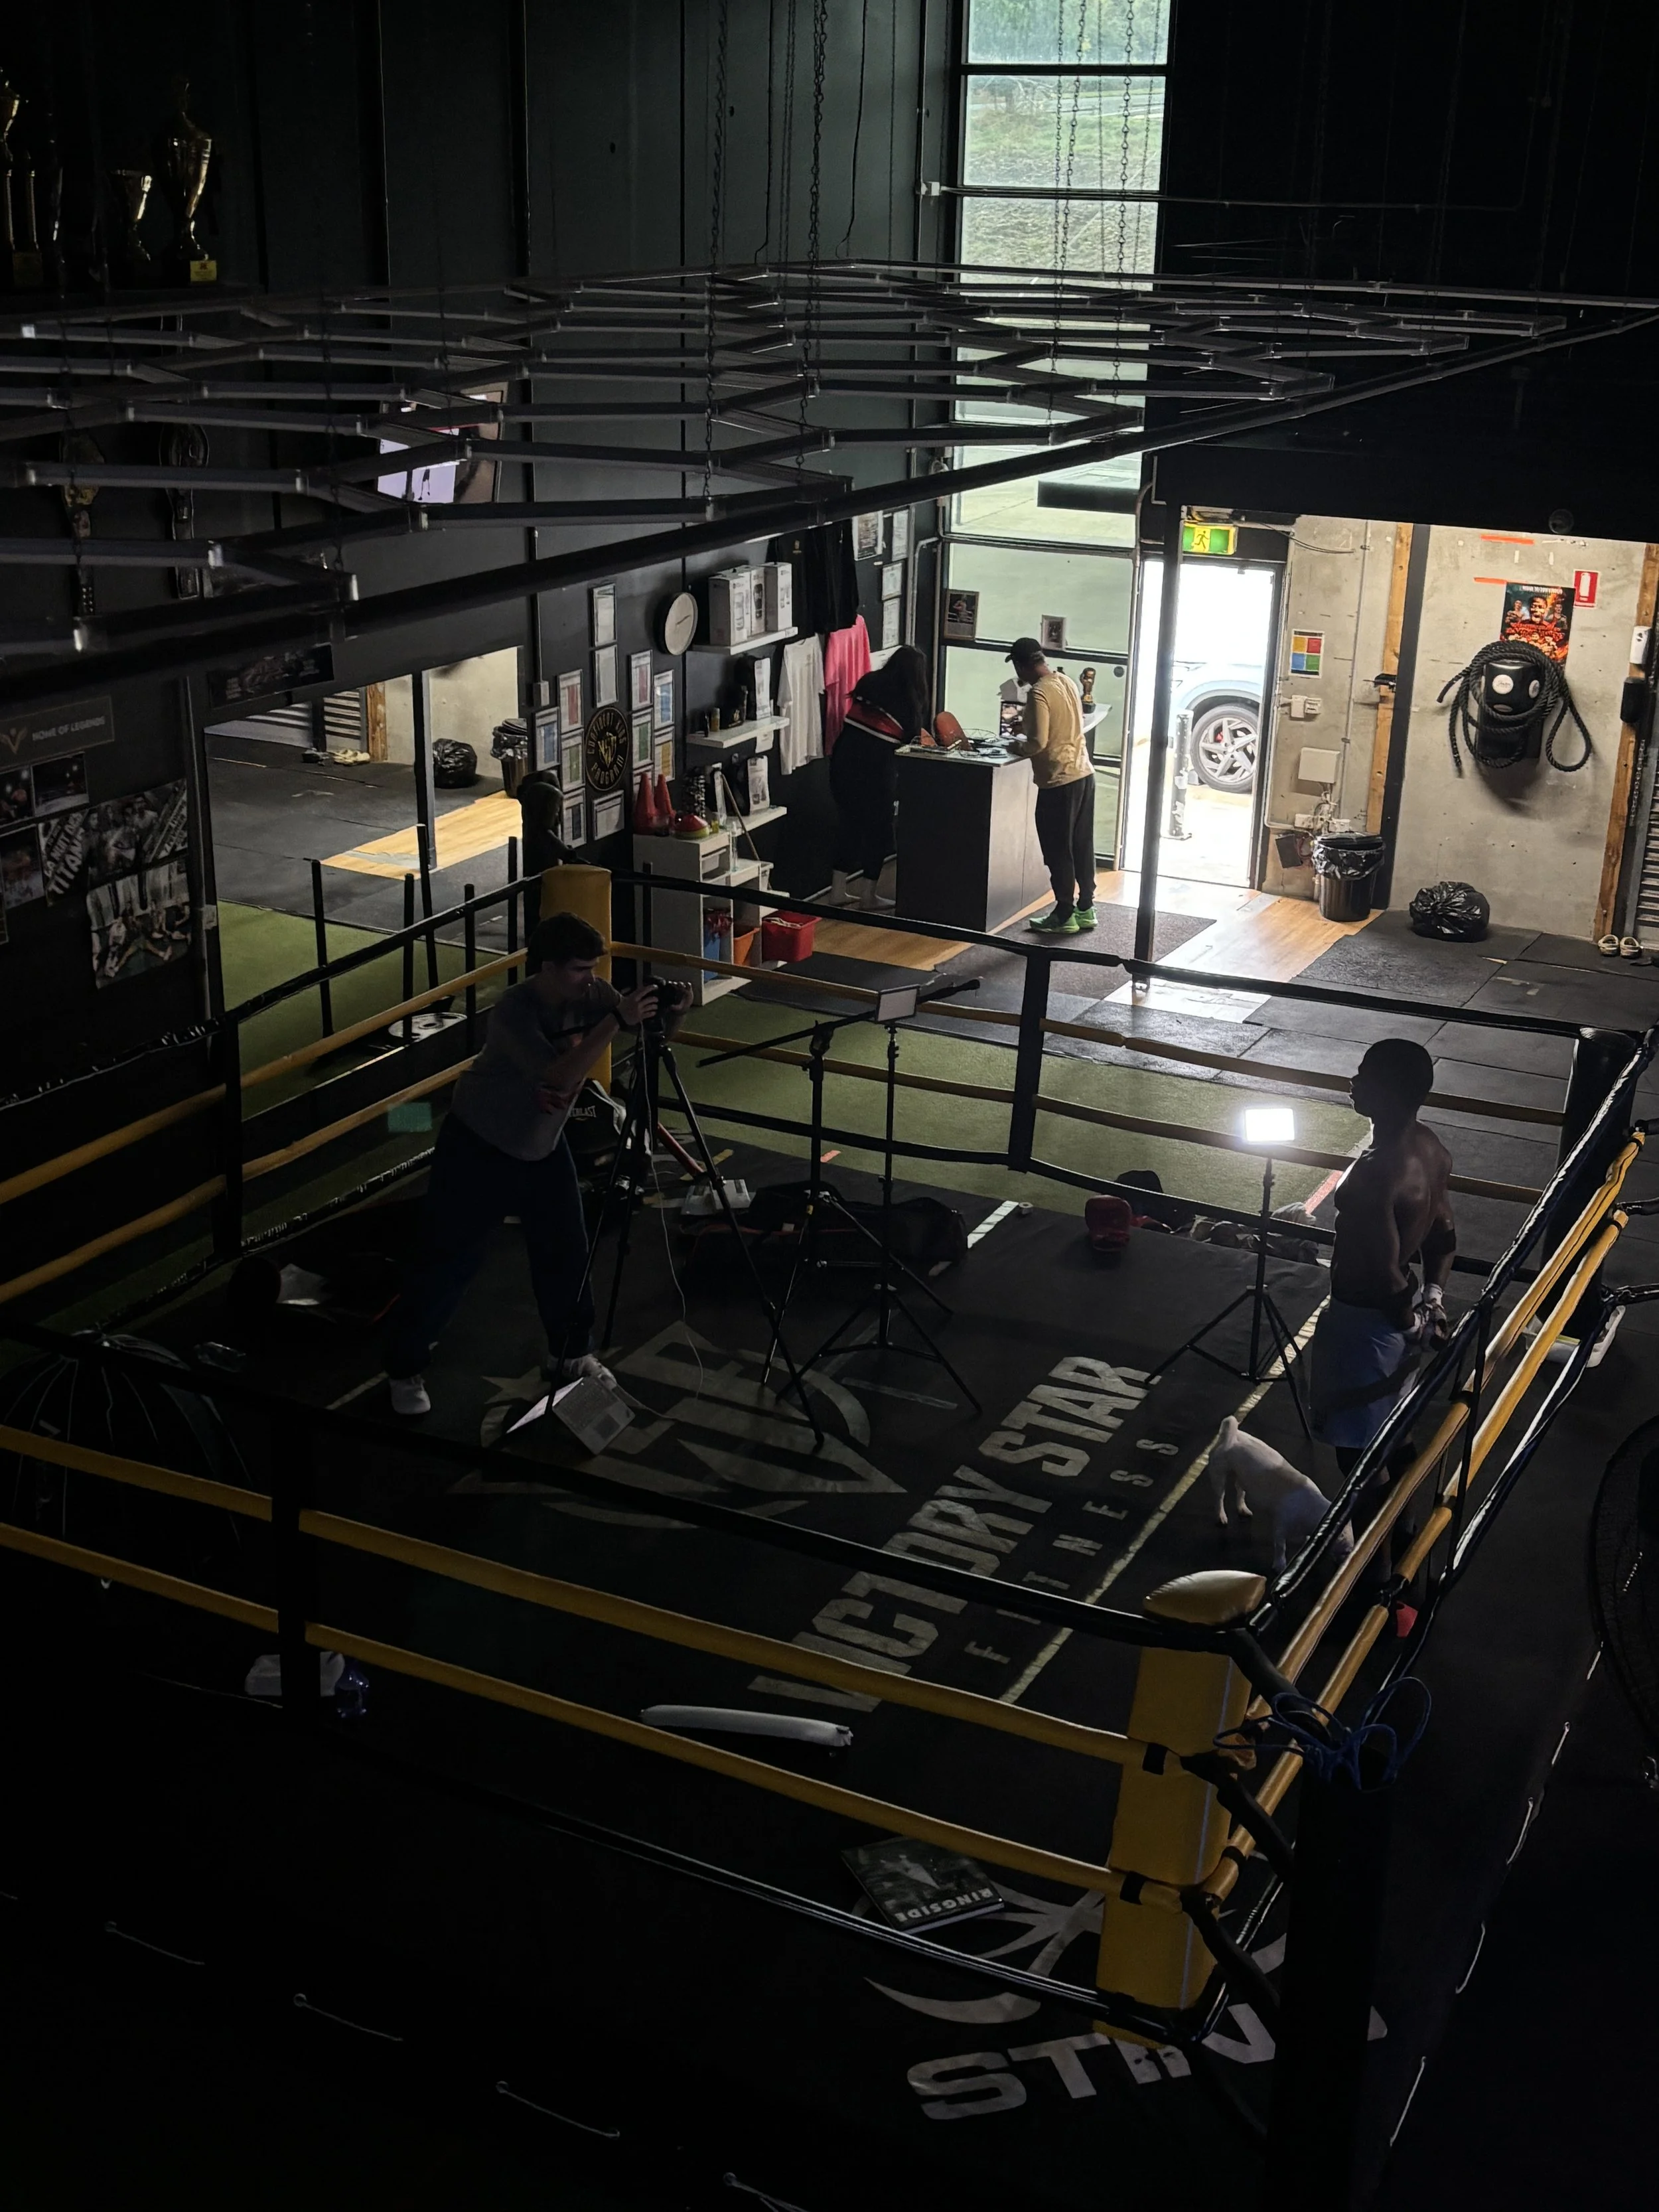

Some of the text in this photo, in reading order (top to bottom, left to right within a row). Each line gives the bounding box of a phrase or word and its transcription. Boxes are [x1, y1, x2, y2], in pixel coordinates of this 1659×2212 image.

[57, 723, 70, 735] OF
[977, 1355, 1162, 1477] STAR
[894, 1887, 994, 1923] RINGSIDE
